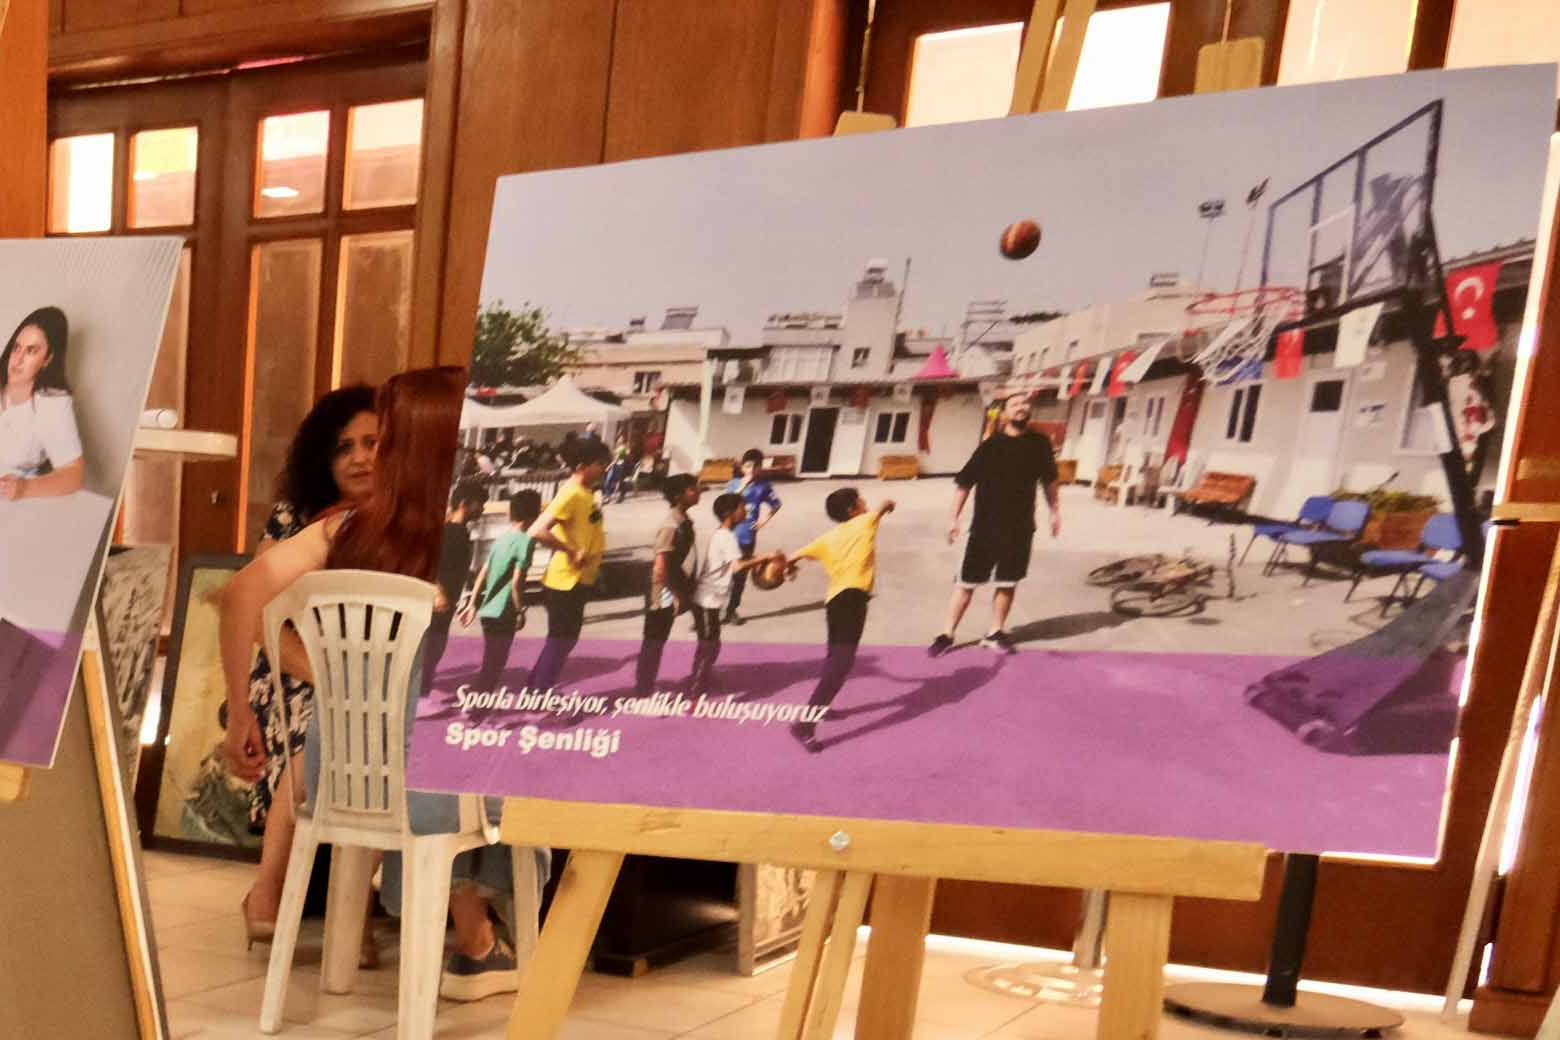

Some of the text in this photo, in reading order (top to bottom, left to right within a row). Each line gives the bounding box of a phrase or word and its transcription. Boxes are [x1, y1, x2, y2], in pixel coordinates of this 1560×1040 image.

[452, 684, 829, 727] Sporla birleşiyor, şenlikle buluşuyoruz
[445, 722, 622, 758] Spor Şenliği
